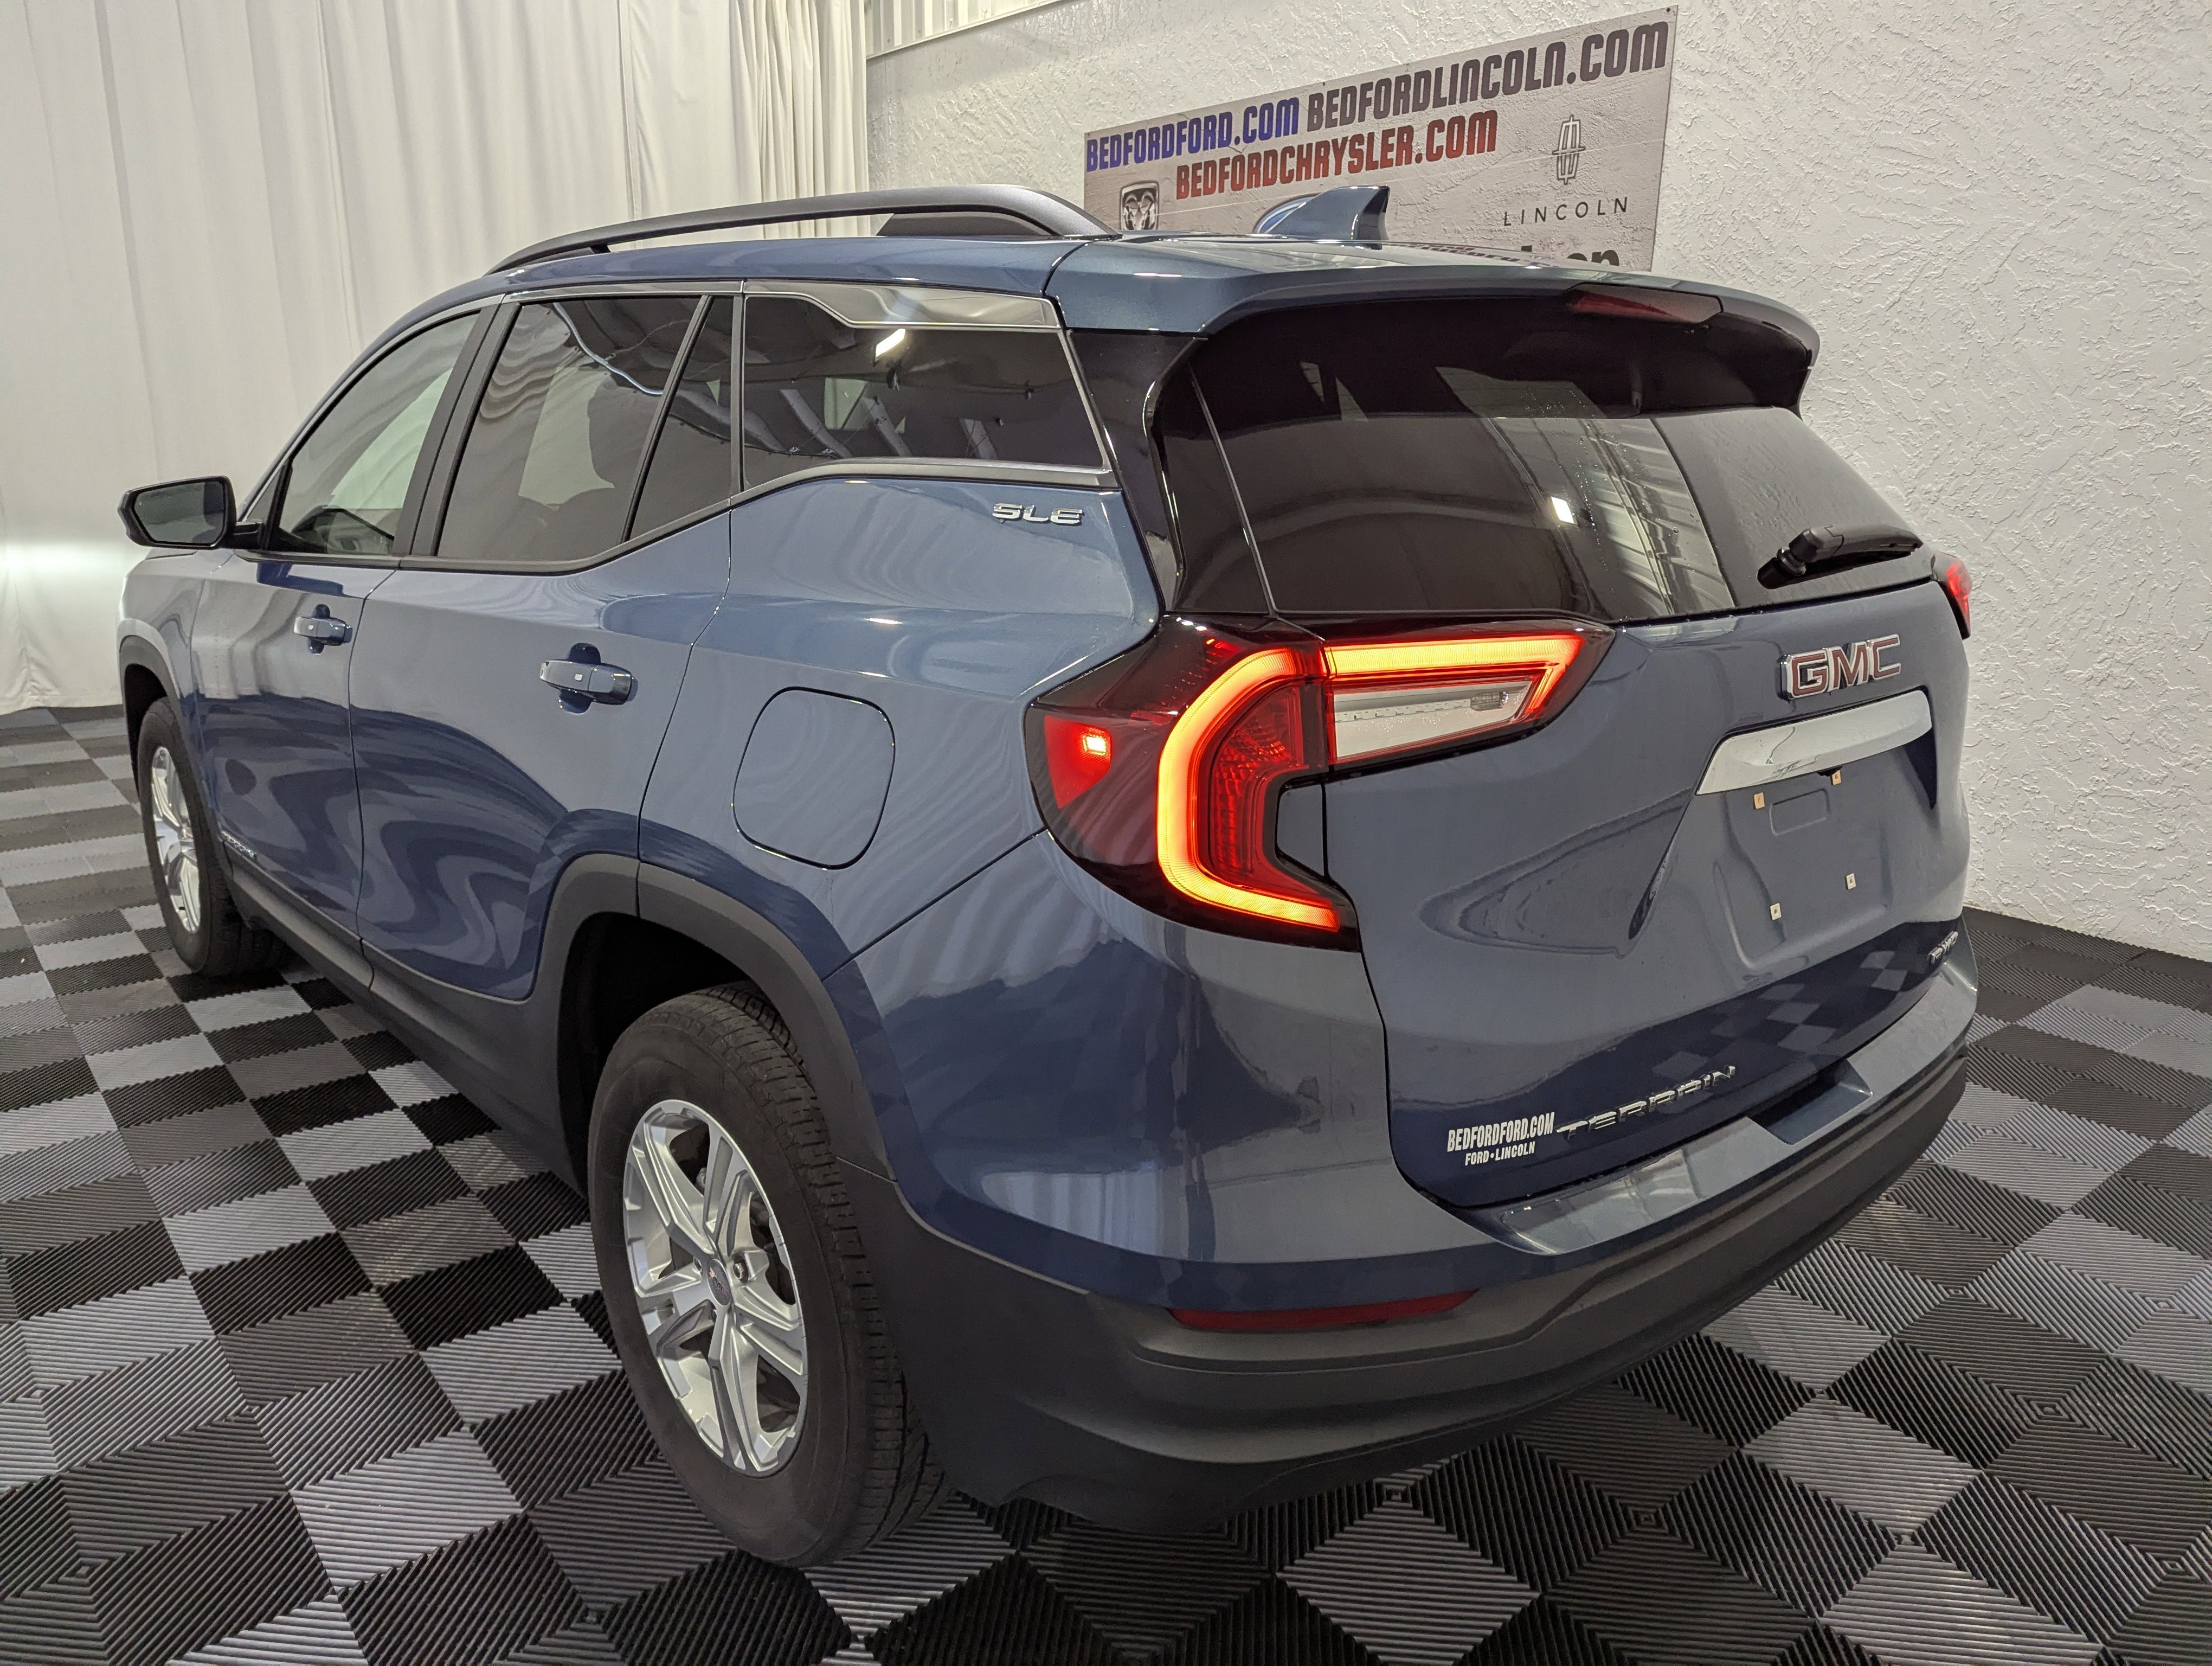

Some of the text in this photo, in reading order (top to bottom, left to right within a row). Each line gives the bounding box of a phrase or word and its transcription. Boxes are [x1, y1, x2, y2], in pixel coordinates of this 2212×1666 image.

[1086, 21, 1669, 172] BEDFORDFORD.COM BEDFORDLINCOLN.COM
[1176, 109, 1498, 200] BEDFORDCHRYSLER.COM
[1503, 196, 1628, 227] LINCOLN
[992, 502, 1083, 526] SLE
[1780, 633, 1901, 700] GMC
[1446, 1111, 1555, 1152] BEDFORDFORD.COM
[1554, 1065, 1736, 1140] TERRAIN
